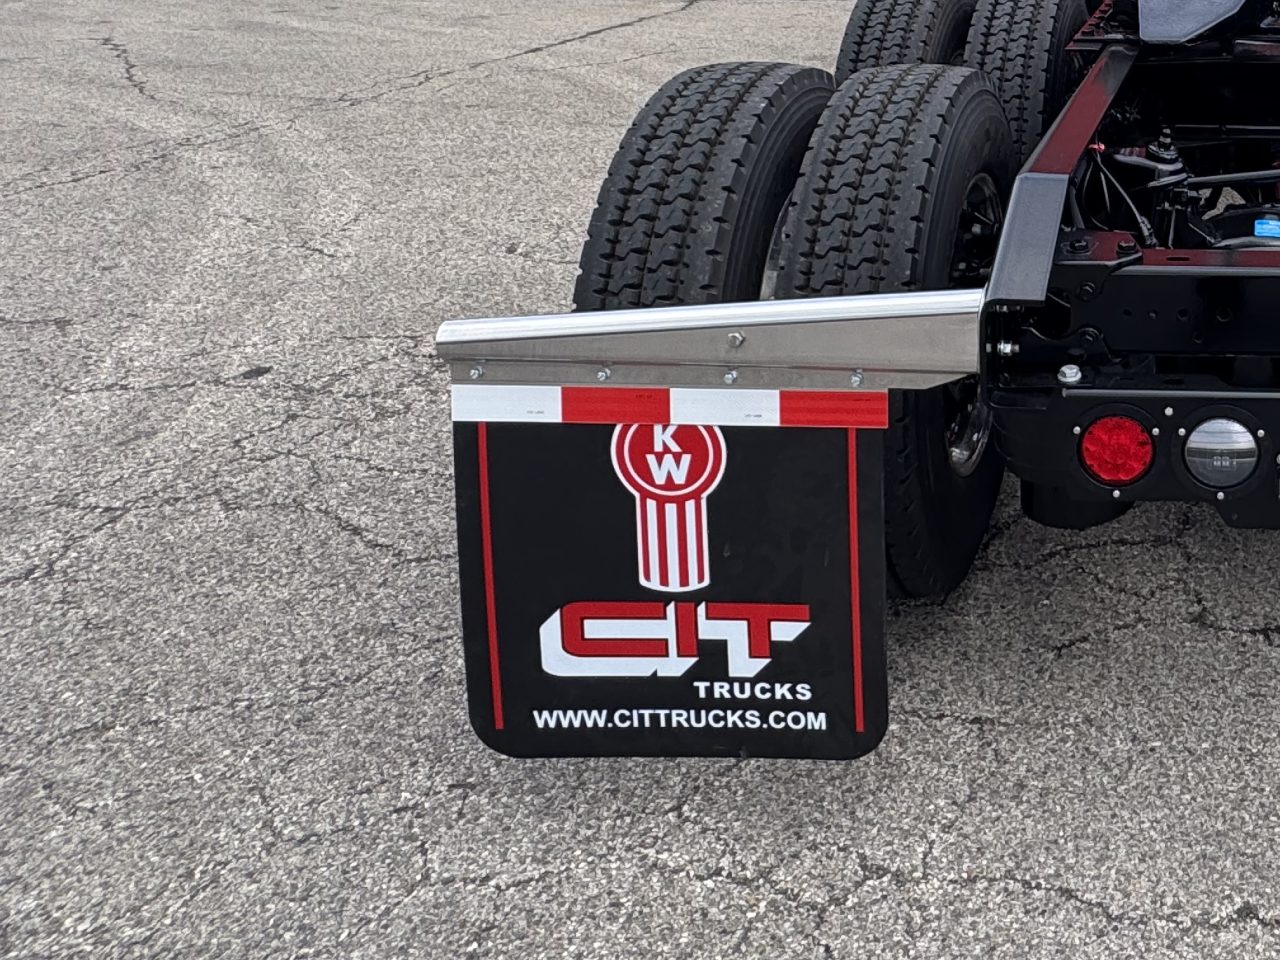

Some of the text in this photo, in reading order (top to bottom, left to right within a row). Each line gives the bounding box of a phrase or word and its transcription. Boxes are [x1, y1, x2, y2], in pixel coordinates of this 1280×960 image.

[539, 600, 812, 678] CIT
[693, 681, 812, 701] TRUCKS
[532, 709, 828, 732] WWW.CITTRUCKS.COM
